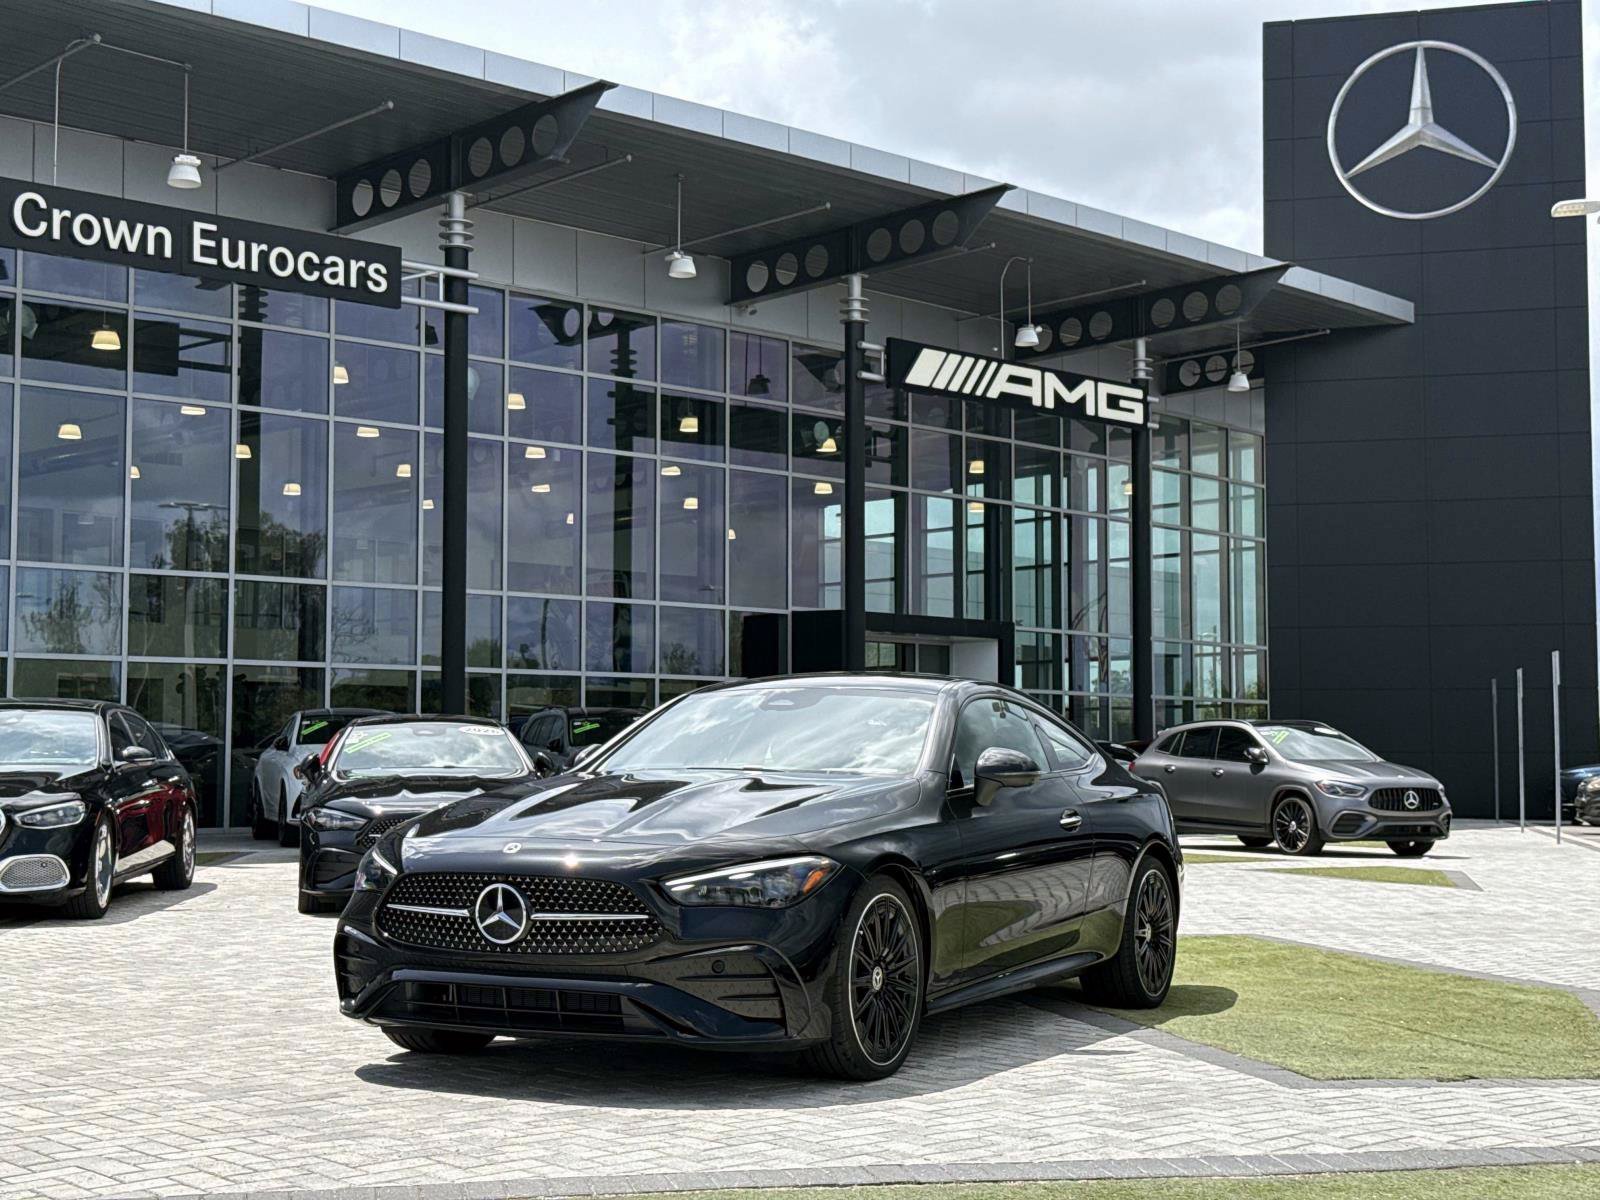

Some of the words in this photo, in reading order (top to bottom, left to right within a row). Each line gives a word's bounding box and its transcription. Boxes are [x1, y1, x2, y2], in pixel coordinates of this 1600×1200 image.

[13, 191, 172, 258] Crown
[193, 221, 388, 293] Eurocars
[986, 363, 1144, 425] AMG
